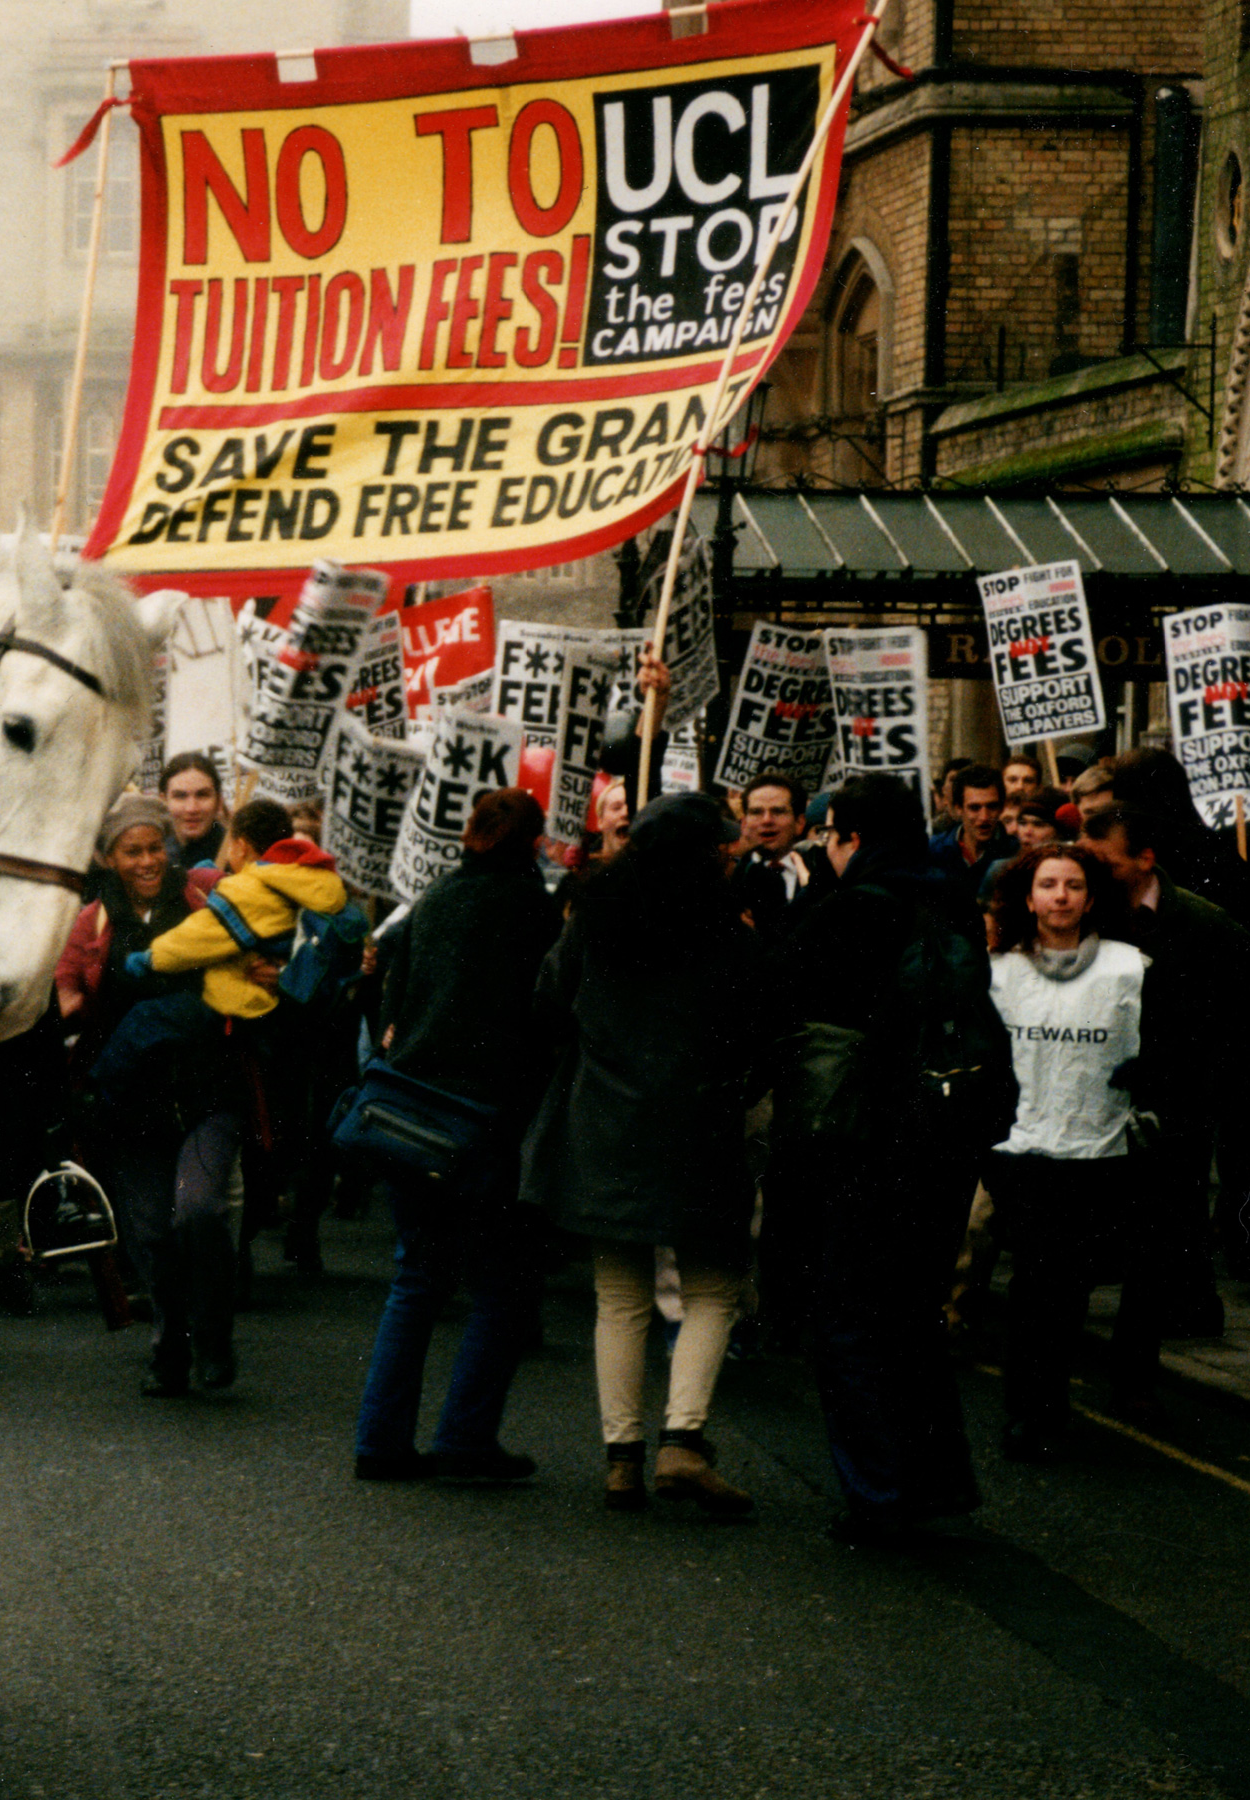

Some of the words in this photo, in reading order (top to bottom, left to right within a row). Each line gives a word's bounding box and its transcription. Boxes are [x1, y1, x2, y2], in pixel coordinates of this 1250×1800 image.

[602, 83, 805, 213] UCL
[180, 124, 349, 266] NO
[413, 97, 586, 245] TO
[602, 206, 799, 280] STOP
[169, 262, 417, 395] TUITION
[418, 233, 592, 373] FEES!
[605, 283, 675, 324] the
[703, 273, 786, 315] fees
[591, 304, 779, 358] CAMPAIGN
[154, 424, 338, 495] SAVE
[374, 417, 511, 477] THE
[536, 380, 752, 468] GRANT
[129, 486, 341, 545] DEFEND
[352, 479, 479, 540] FREE
[982, 575, 1020, 598] STOP
[758, 628, 821, 655] STOP
[990, 606, 1083, 647] DEGREES
[1170, 611, 1224, 639] STOP
[994, 638, 1089, 685] FEES
[1000, 674, 1089, 707] SUPPORT
[1024, 694, 1092, 719] OXFORD
[735, 698, 837, 743] FEES
[1006, 709, 1097, 738] NON-PAYERS
[730, 752, 760, 773] THE
[732, 732, 830, 764] SUPPORT
